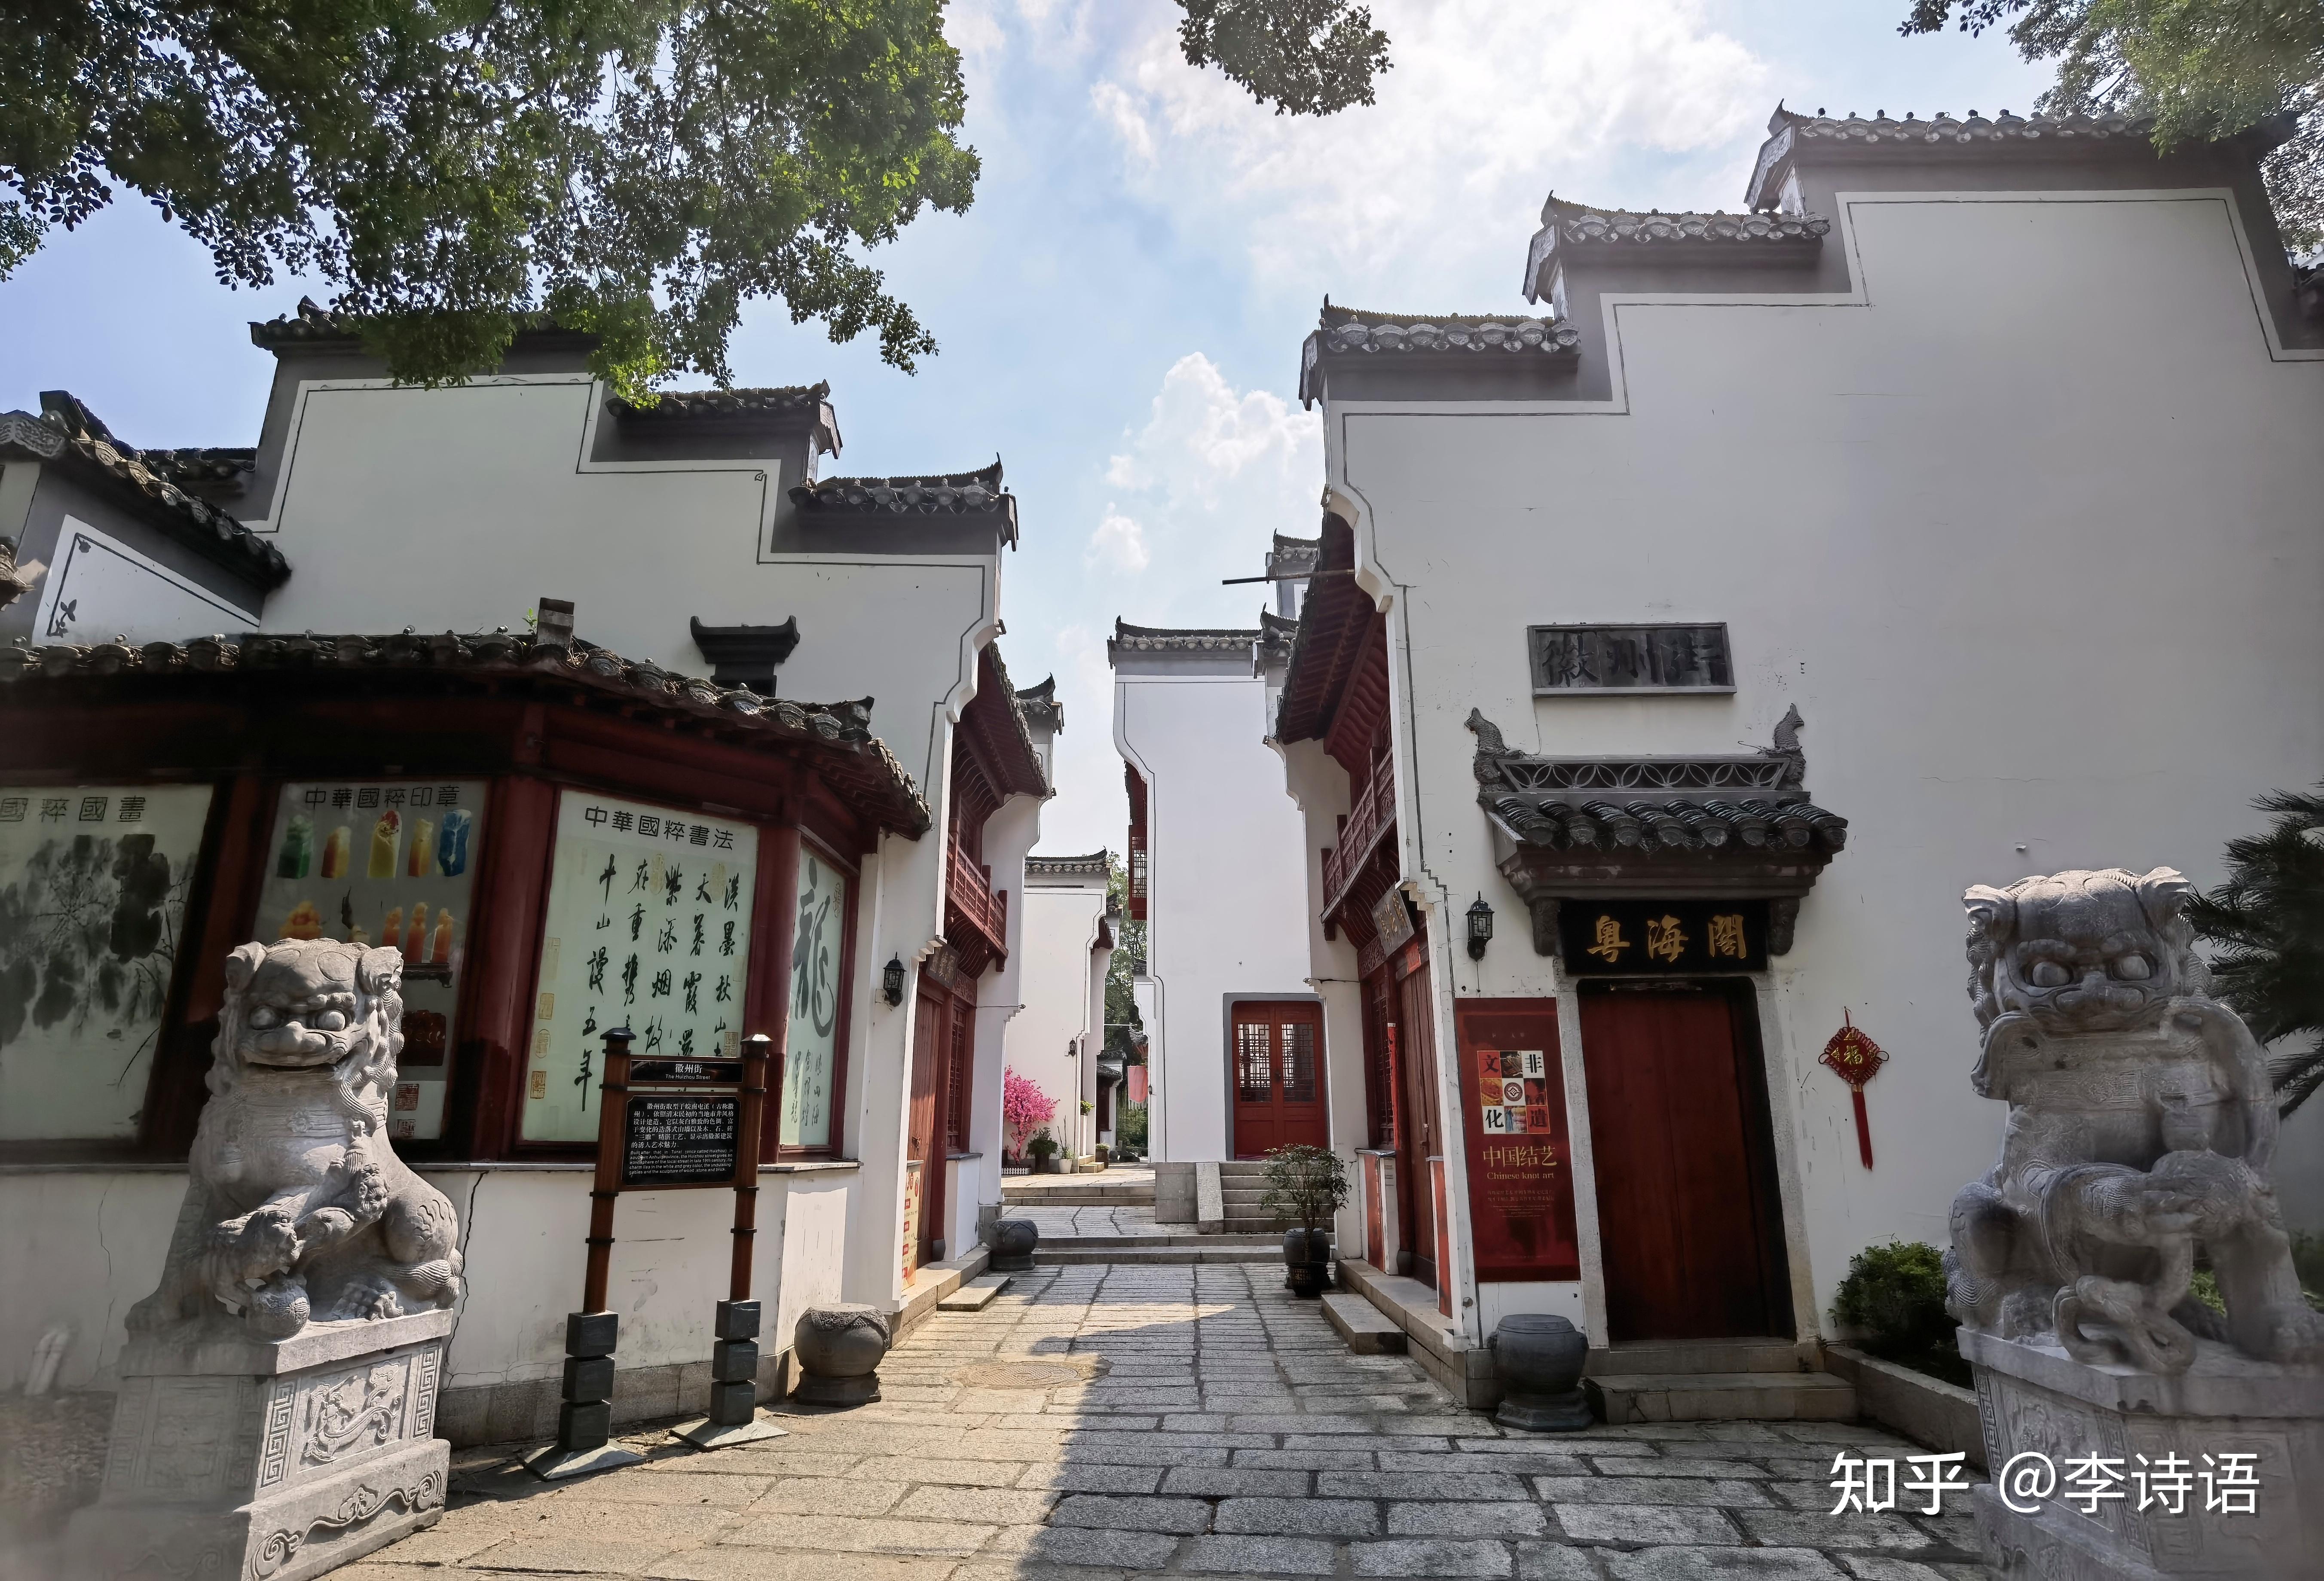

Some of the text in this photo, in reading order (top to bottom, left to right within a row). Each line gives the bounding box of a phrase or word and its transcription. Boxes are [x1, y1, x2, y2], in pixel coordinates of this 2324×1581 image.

[305, 785, 460, 809] 中華國粹印章
[585, 806, 733, 850] 中華國粹書法
[1482, 1054, 1499, 1073] 文
[1525, 1054, 1543, 1073] 非
[1844, 1045, 1863, 1065] 福
[675, 1064, 703, 1074] 徽州街
[1486, 1109, 1504, 1128] 化
[1483, 1146, 1557, 1167] 中国结艺
